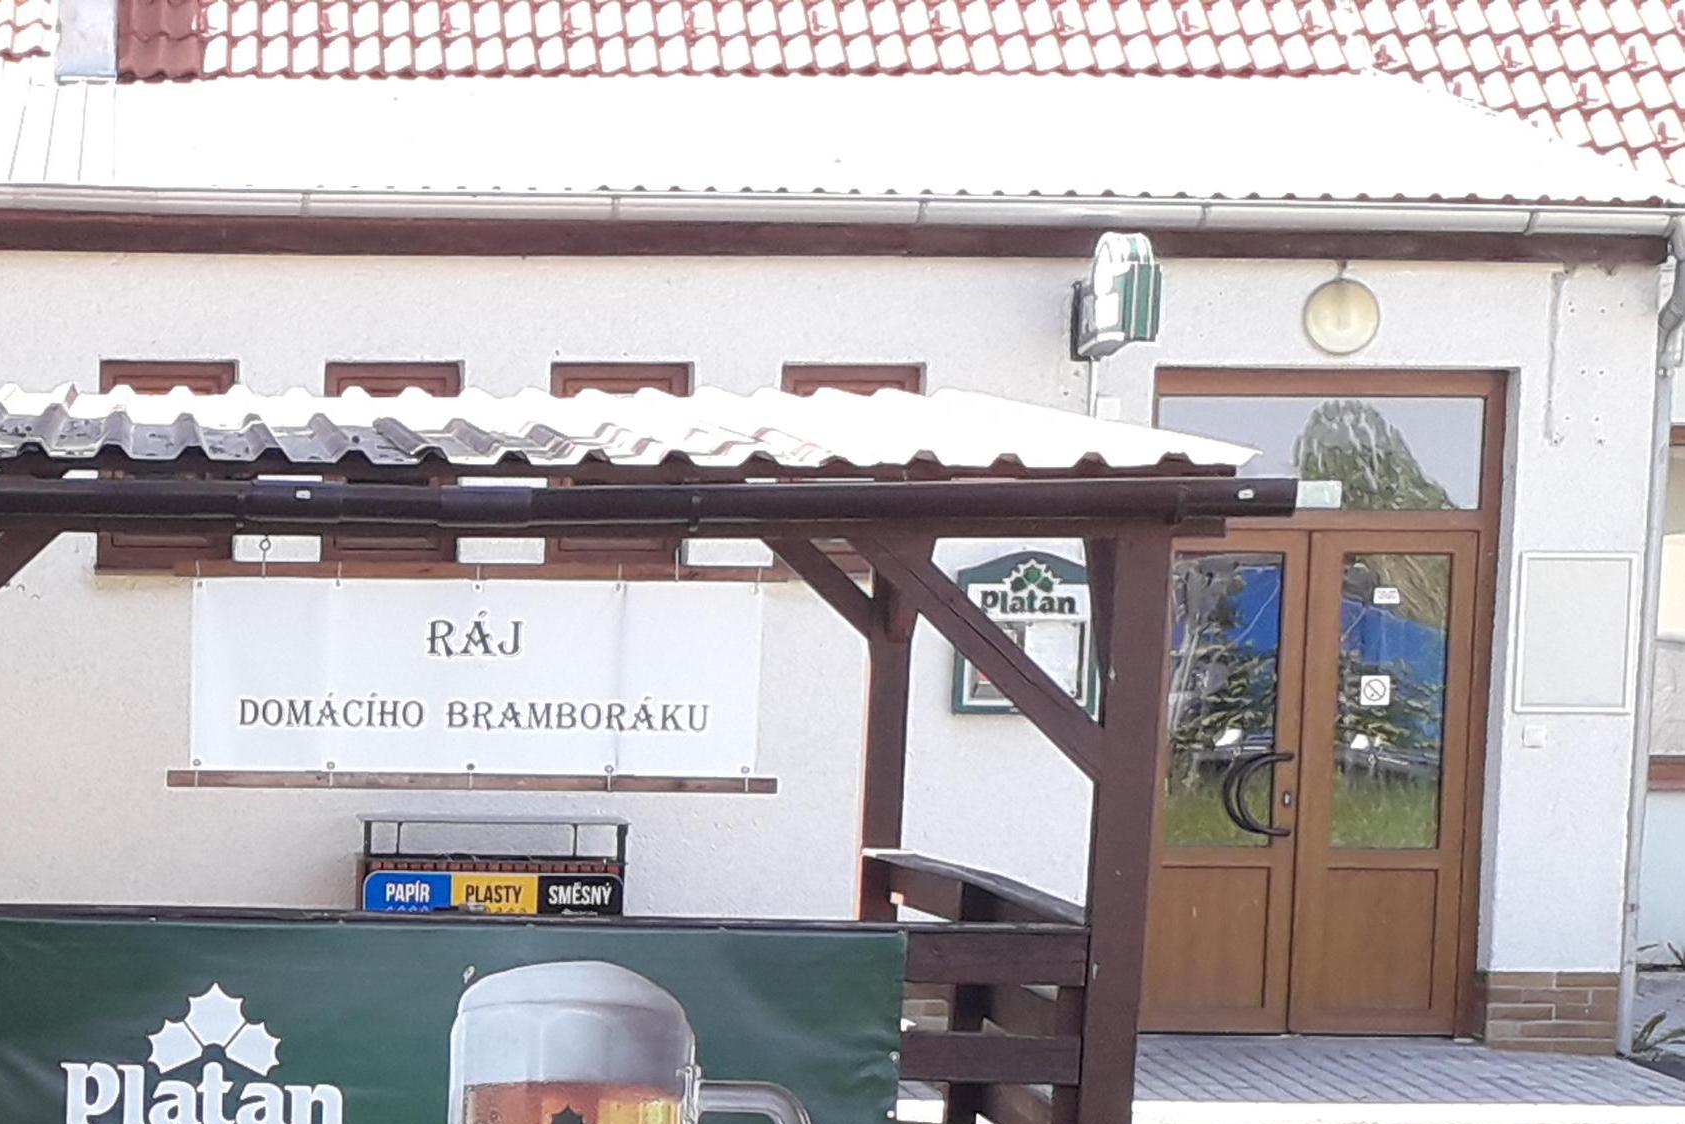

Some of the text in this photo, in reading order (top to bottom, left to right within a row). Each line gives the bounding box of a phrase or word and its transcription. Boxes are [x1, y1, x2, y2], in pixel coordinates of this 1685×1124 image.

[427, 611, 524, 658] RÁJ
[239, 692, 710, 732] DOMÁCÍHO BRAMBORÁKU
[385, 880, 431, 903] PAPÍR
[465, 884, 523, 904] PLASTY
[548, 881, 612, 905] SMĚSNÝ
